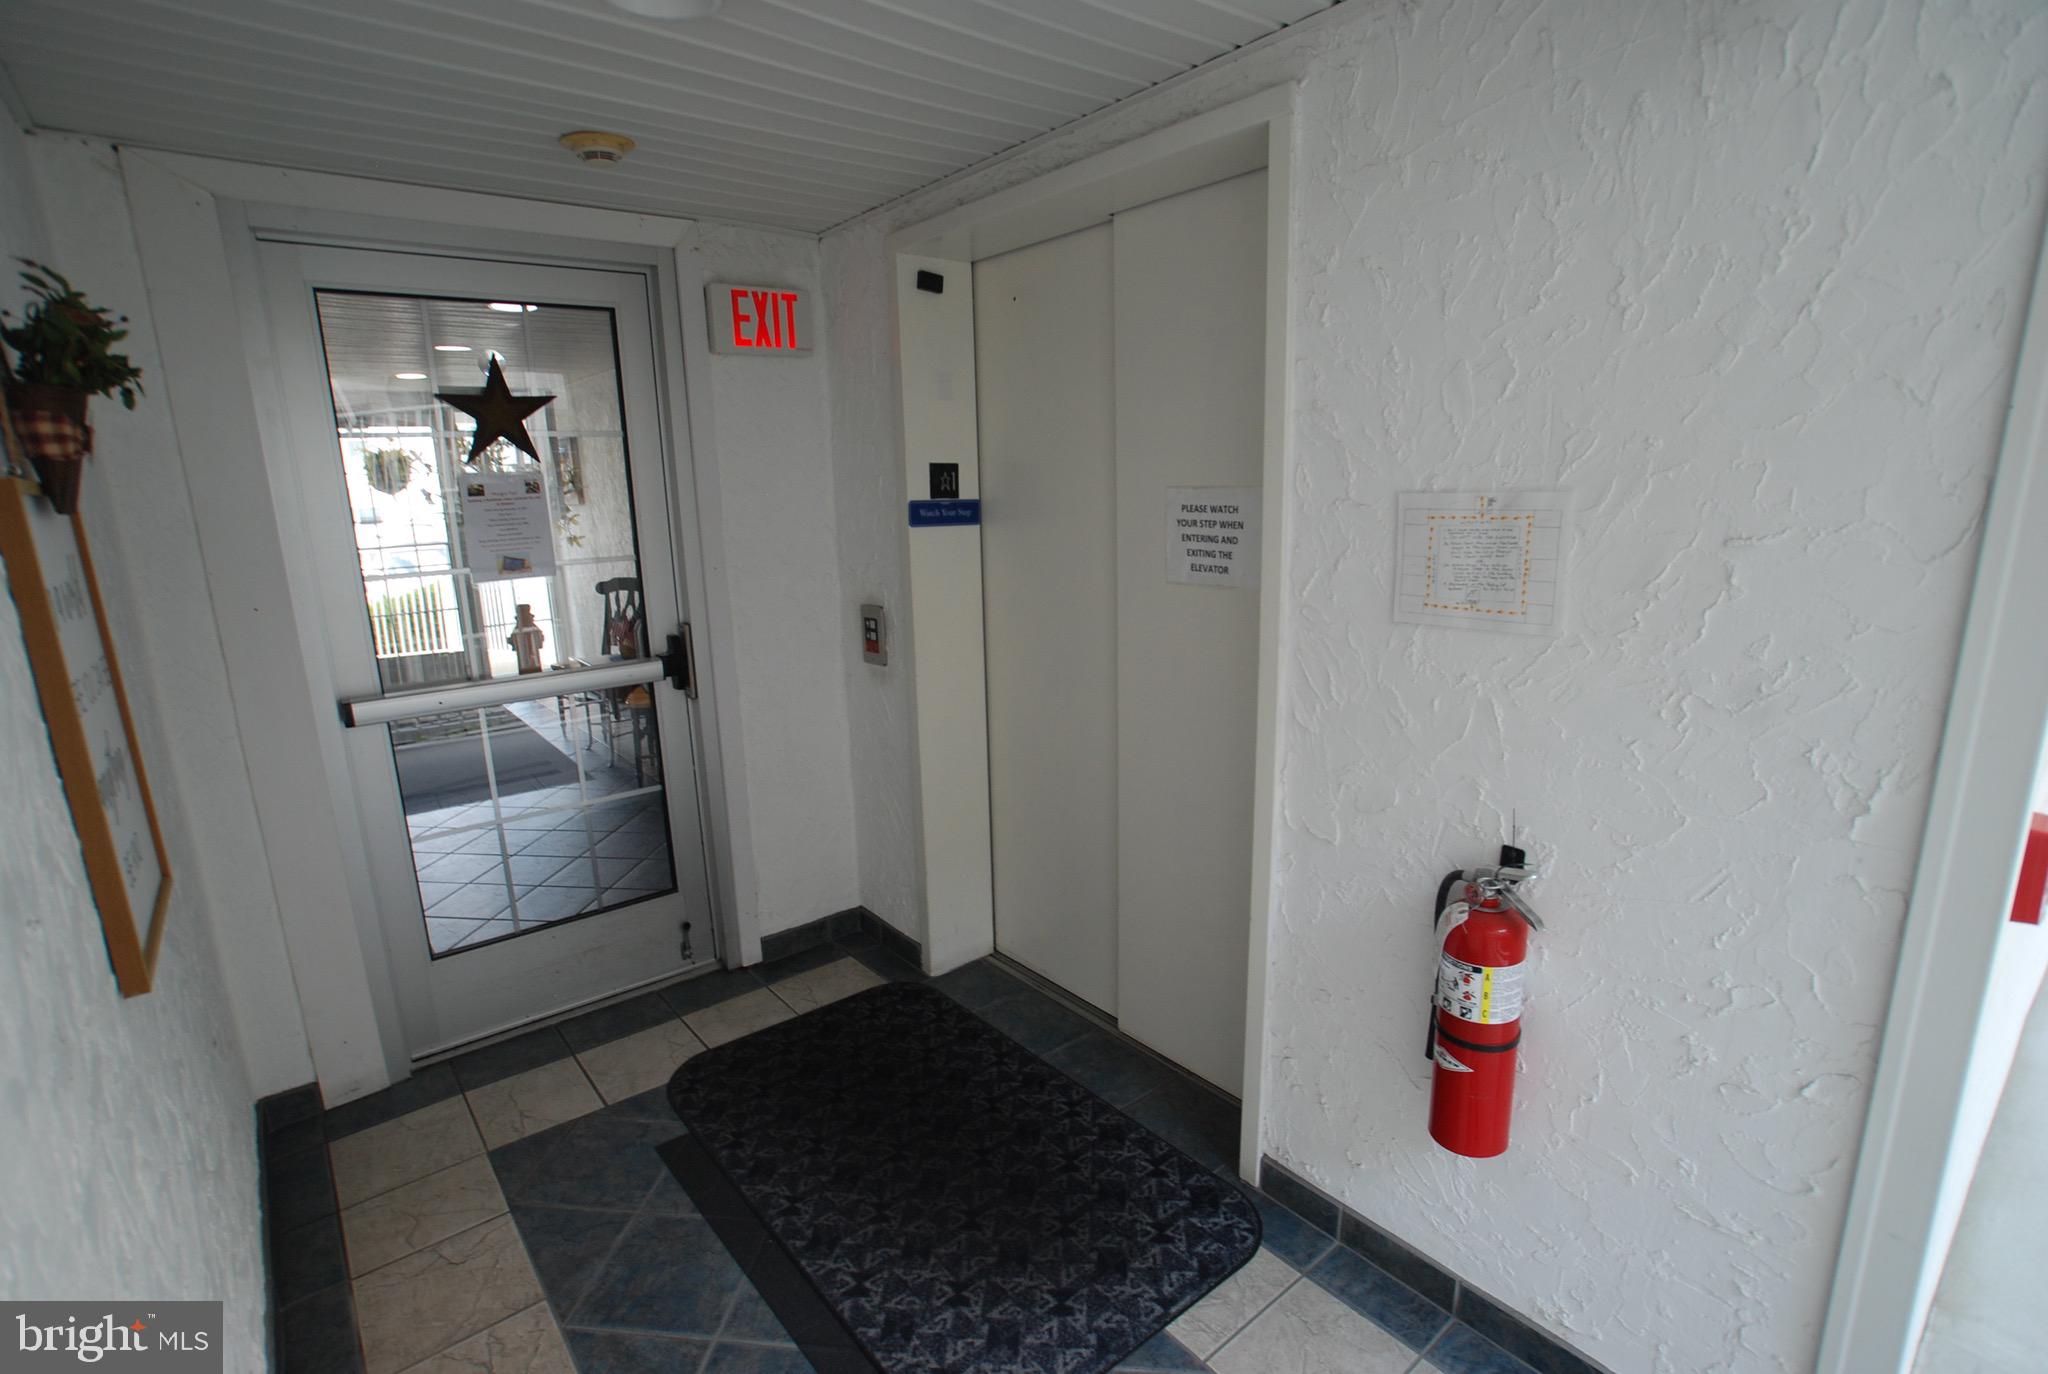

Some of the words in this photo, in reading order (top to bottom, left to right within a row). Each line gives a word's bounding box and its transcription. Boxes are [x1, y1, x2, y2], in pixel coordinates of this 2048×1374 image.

[731, 288, 798, 349] EXIT
[1181, 504, 1207, 513] PLEASE
[1210, 505, 1239, 514] WATCH
[1177, 519, 1198, 528] YOUR
[1200, 520, 1217, 529] STEP
[1219, 520, 1244, 530] WHEN
[1181, 533, 1219, 544] ENTERING
[1221, 536, 1239, 545] AND
[1187, 548, 1216, 559] EXITING
[1218, 550, 1233, 560] THE
[1190, 563, 1229, 574] ELEVATOR
